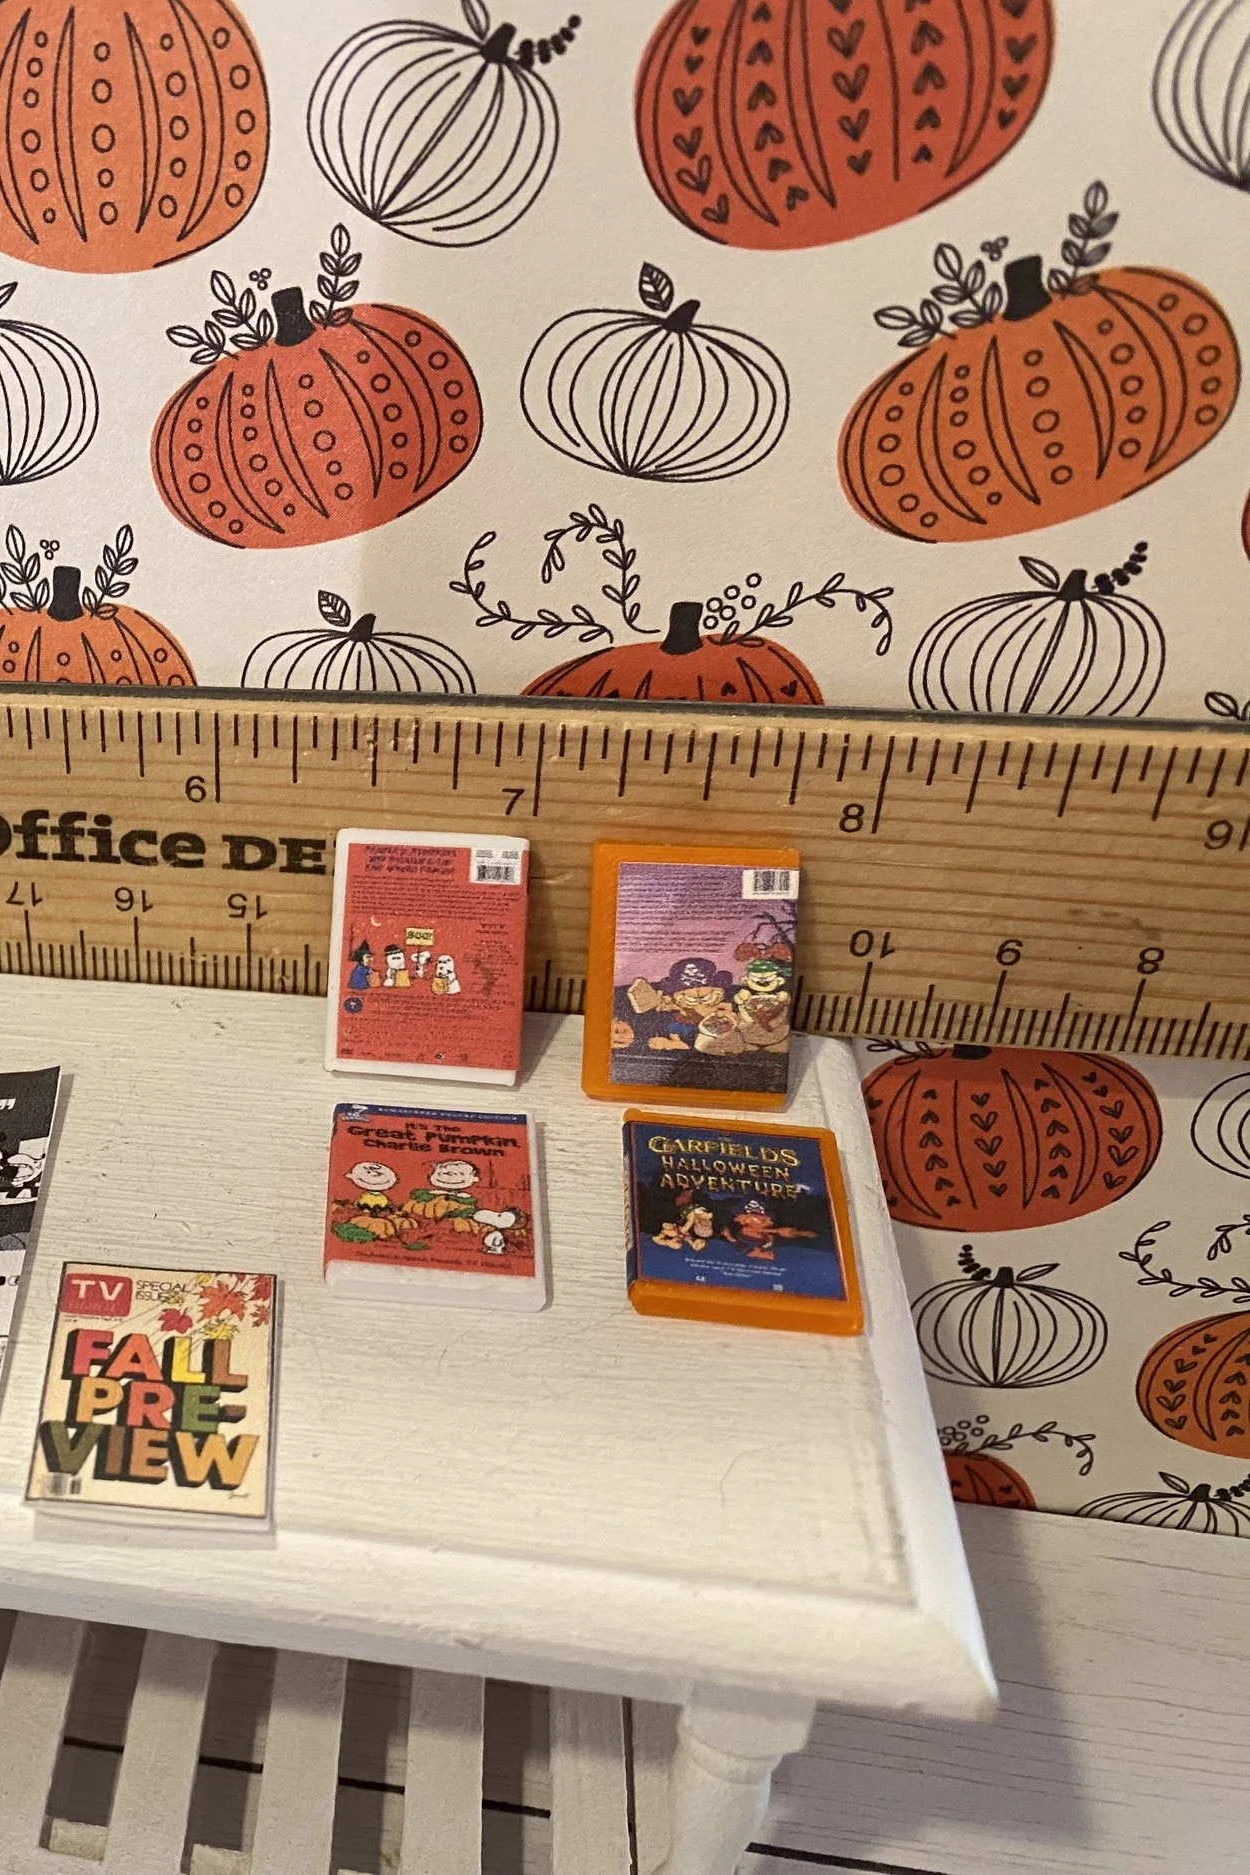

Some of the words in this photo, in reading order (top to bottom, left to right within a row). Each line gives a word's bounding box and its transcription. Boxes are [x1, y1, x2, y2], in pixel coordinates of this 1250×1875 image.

[185, 776, 207, 803] 6
[501, 788, 526, 815] 7
[839, 803, 865, 833] 8
[1204, 819, 1234, 850] 9
[221, 834, 336, 876] DE
[5, 881, 44, 906] 17
[114, 886, 154, 914] 16
[227, 893, 268, 920] 15
[849, 930, 896, 958] 10
[1137, 947, 1164, 974] 8
[347, 1125, 417, 1141] Great
[434, 1124, 461, 1133] The
[363, 1138, 431, 1152] Charlie
[439, 1144, 505, 1157] Brown
[661, 1155, 790, 1181] HALLOWEEN
[660, 1173, 799, 1200] ADVENTURE
[71, 1279, 124, 1301] TV
[135, 1280, 191, 1292] SPECIAL
[135, 1290, 168, 1301] ISSUE
[62, 1328, 248, 1392] FALL
[38, 1420, 260, 1490] VIEW
